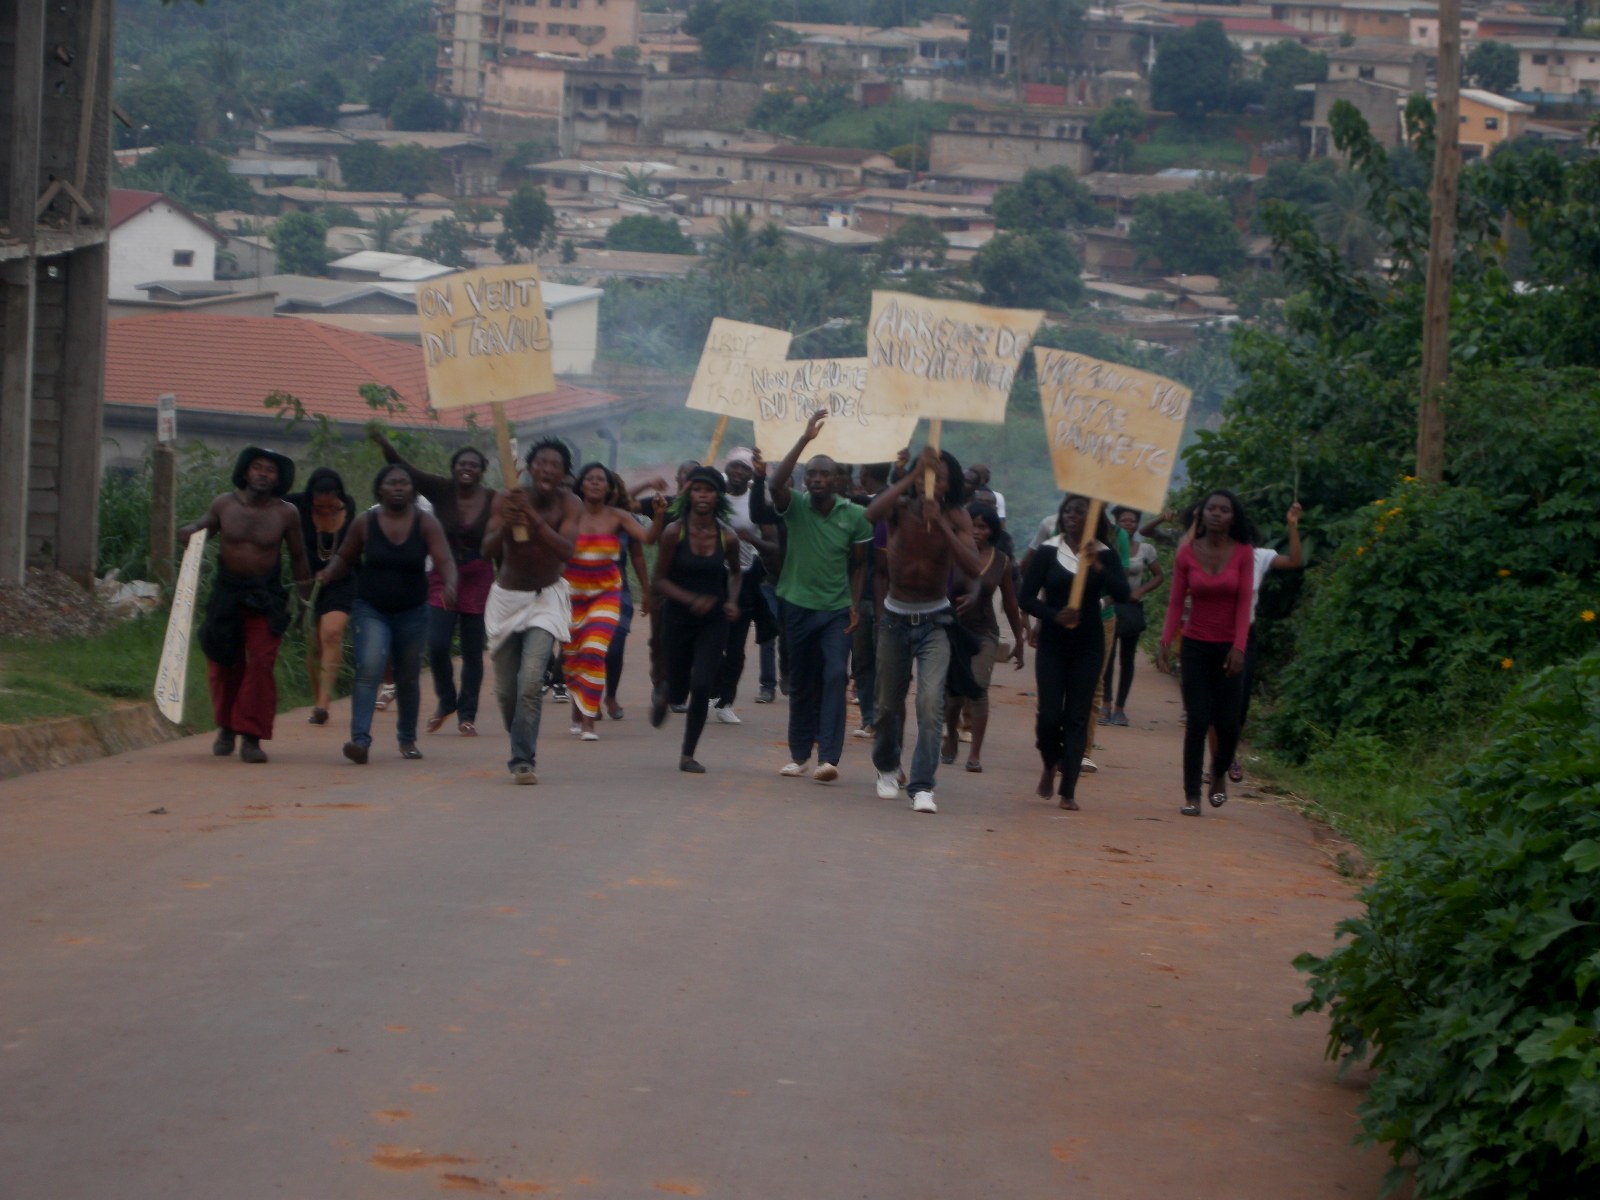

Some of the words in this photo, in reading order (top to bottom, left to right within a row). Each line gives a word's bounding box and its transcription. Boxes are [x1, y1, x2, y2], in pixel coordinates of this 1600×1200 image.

[420, 281, 454, 320] ON
[464, 276, 537, 313] VEUT
[751, 366, 789, 394] NON
